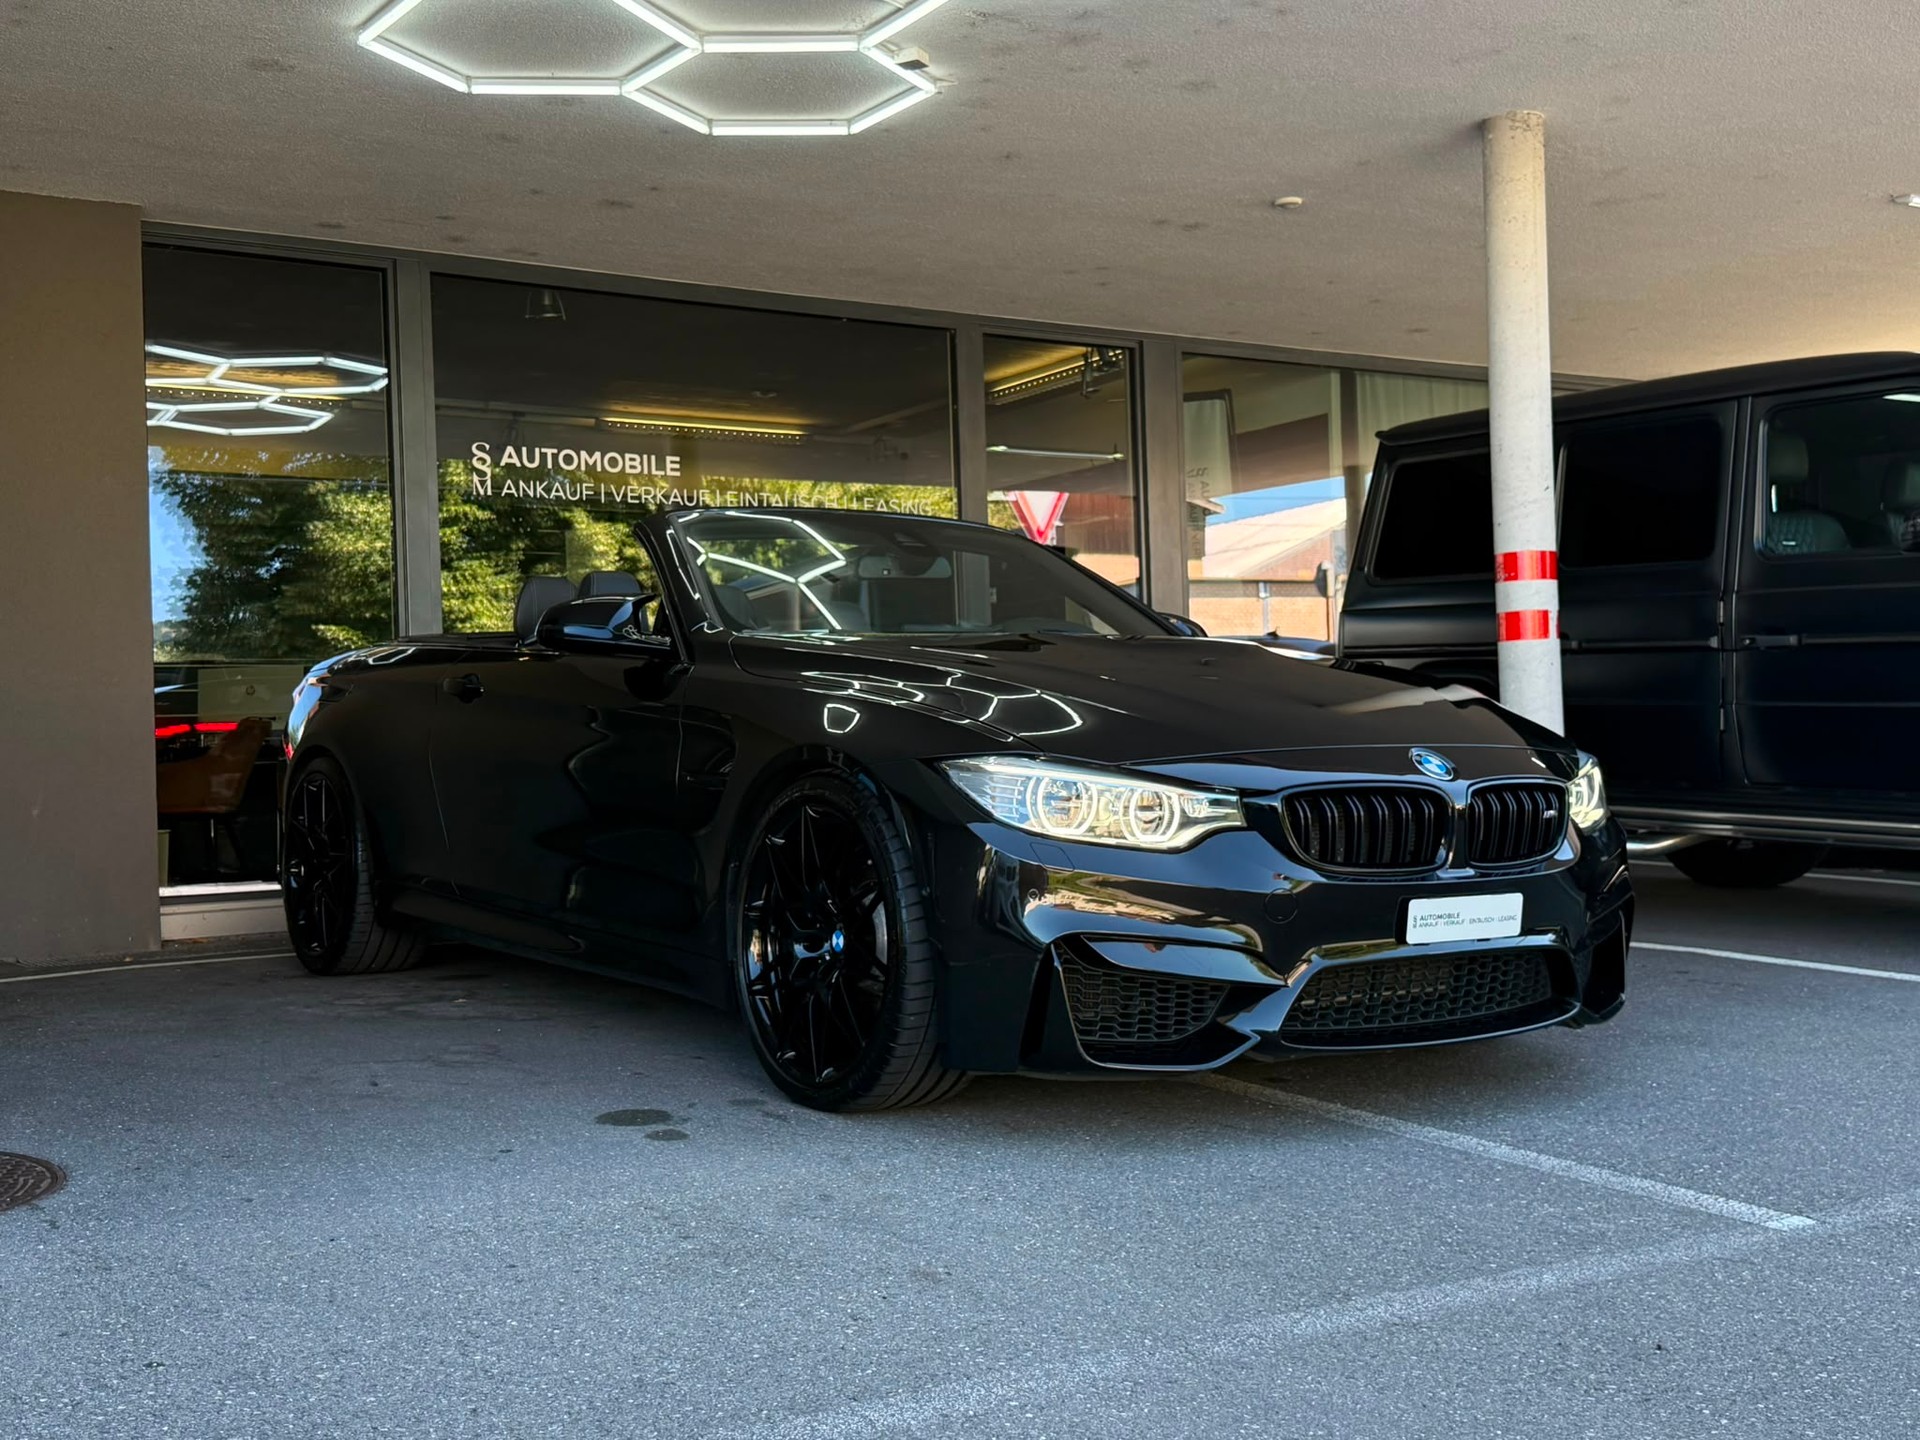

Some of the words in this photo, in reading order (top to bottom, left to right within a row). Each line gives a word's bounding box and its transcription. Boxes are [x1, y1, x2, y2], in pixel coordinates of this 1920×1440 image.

[500, 445, 681, 477] AUTOMOBILE
[501, 479, 595, 501] ANKAUF
[610, 484, 710, 507] VERKAUF
[1419, 911, 1460, 921] AUTOMOBILE
